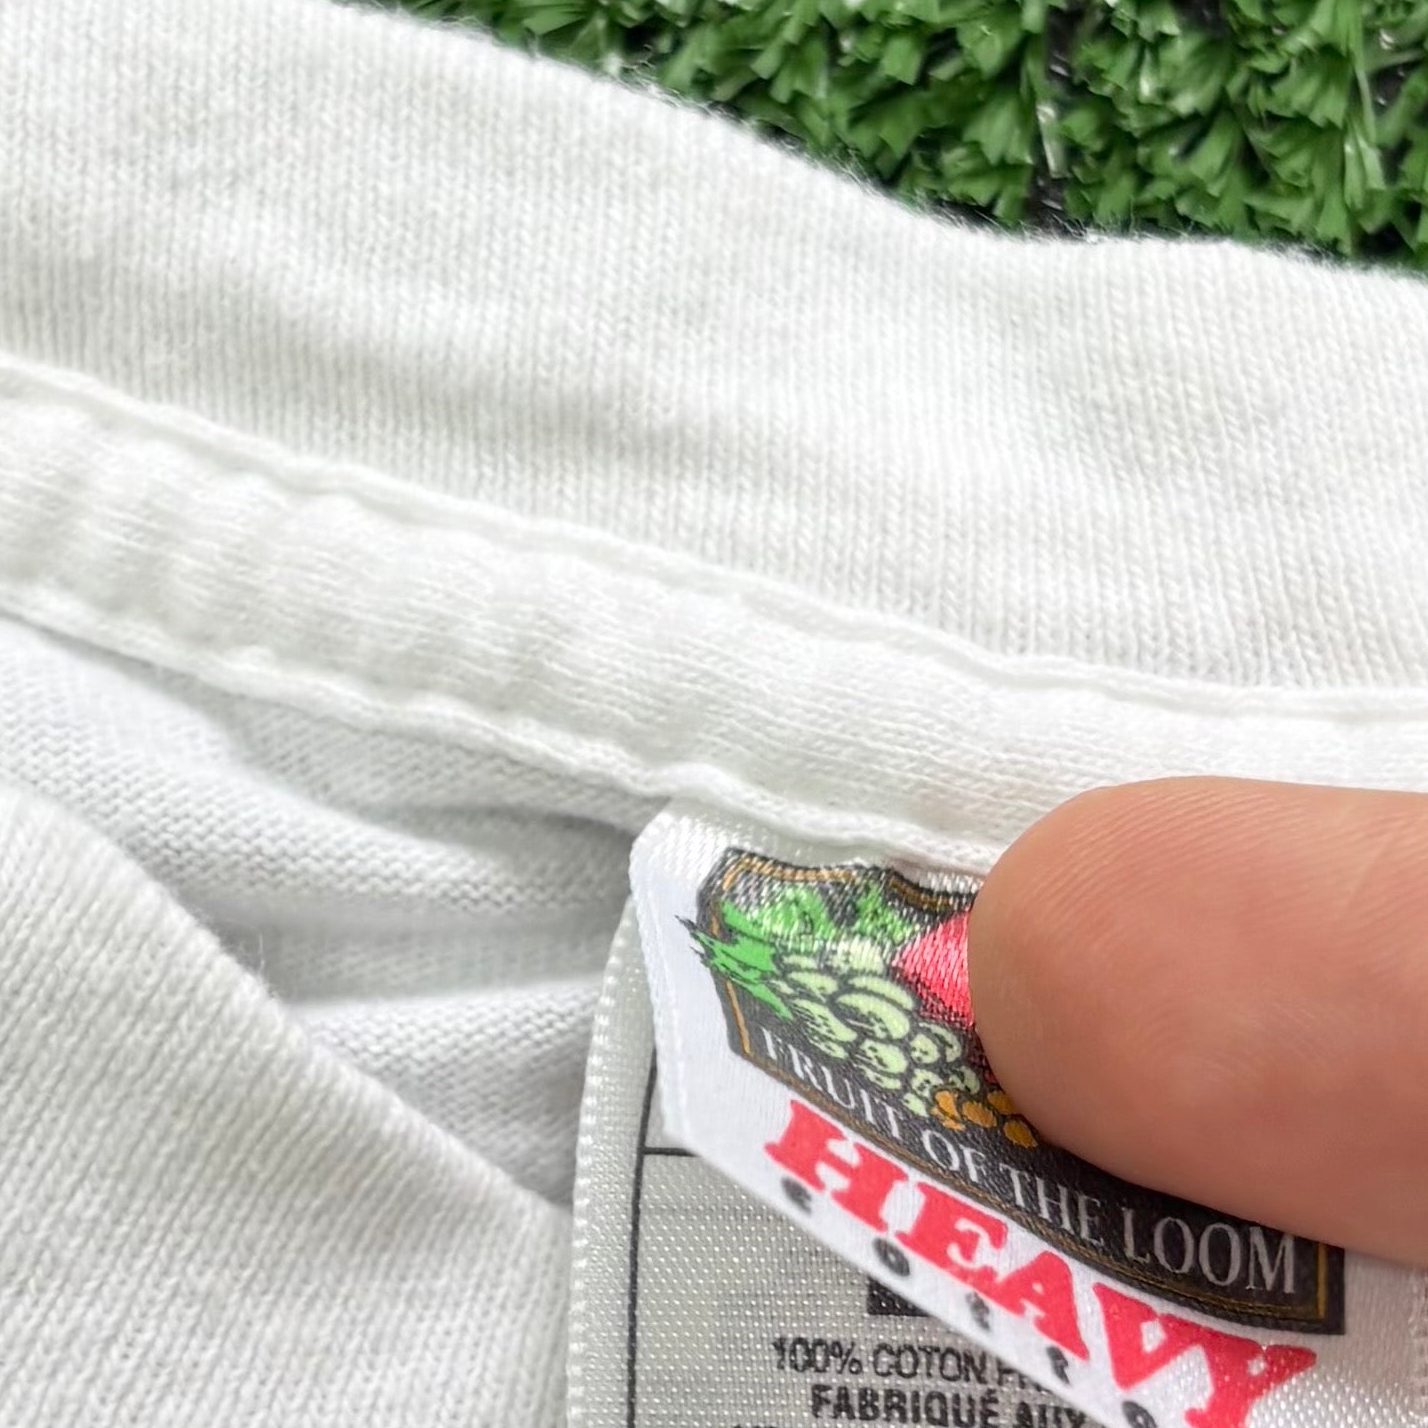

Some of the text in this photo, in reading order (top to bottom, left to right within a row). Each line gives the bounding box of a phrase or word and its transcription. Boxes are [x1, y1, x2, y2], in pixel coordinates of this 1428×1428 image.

[759, 1024, 1296, 1294] FRUIT OF THE LOOM
[772, 1334, 863, 1376] 100%
[872, 1341, 988, 1385] COTON
